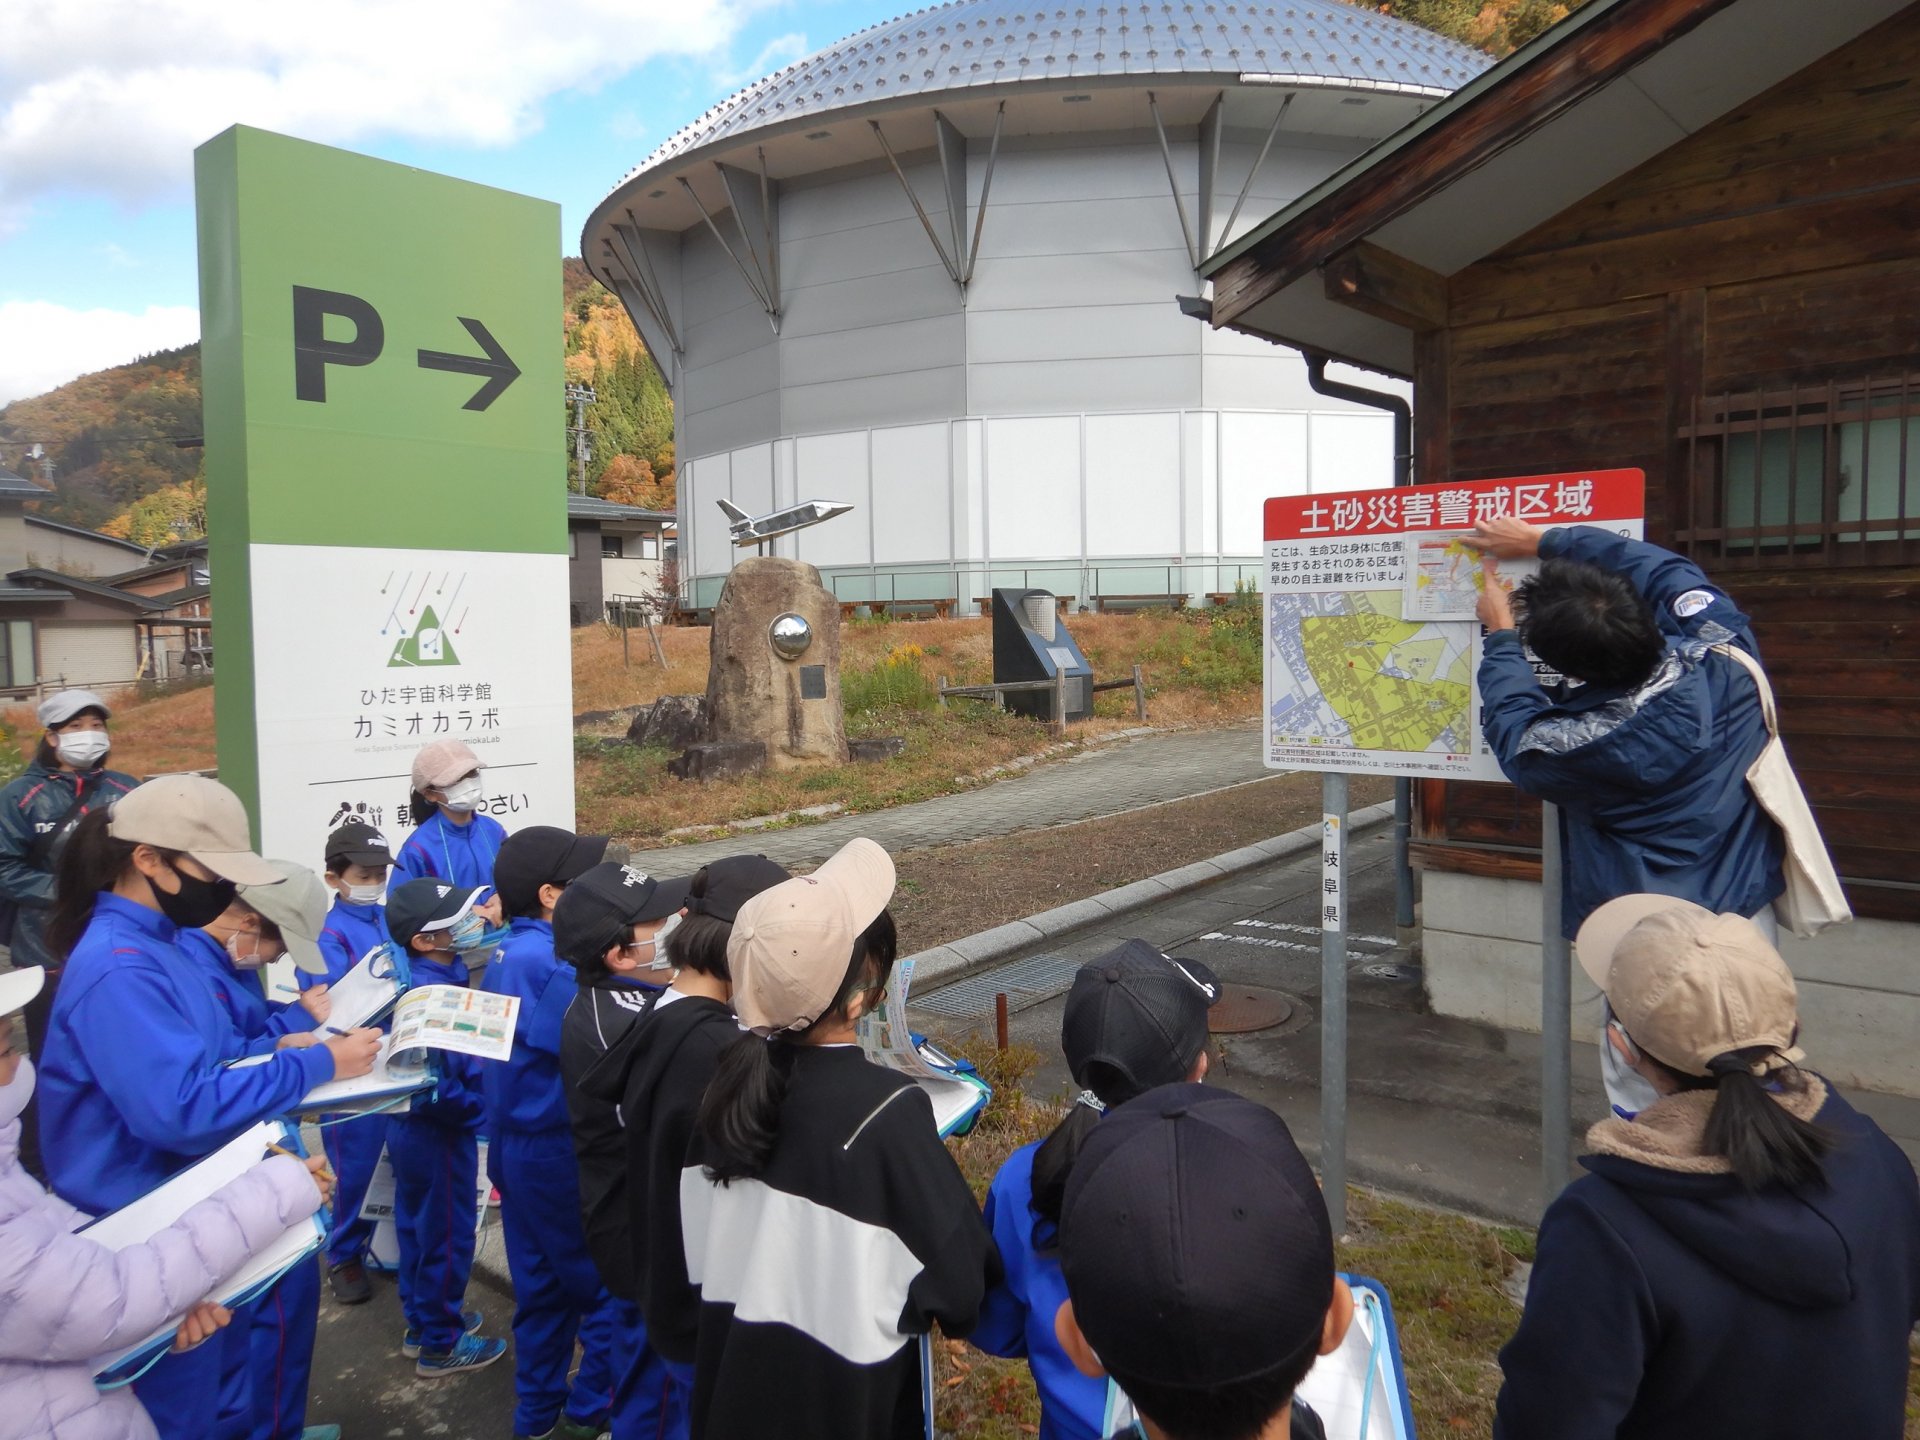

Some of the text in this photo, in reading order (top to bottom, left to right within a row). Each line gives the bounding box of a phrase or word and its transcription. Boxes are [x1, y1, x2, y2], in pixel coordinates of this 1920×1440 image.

[292, 285, 385, 403] P
[1300, 479, 1593, 533] 土砂災害警戒区域
[360, 682, 492, 706] ひだ宇宙科学館
[354, 707, 500, 738] カミオカラボ
[1324, 850, 1338, 923] 岐阜県
